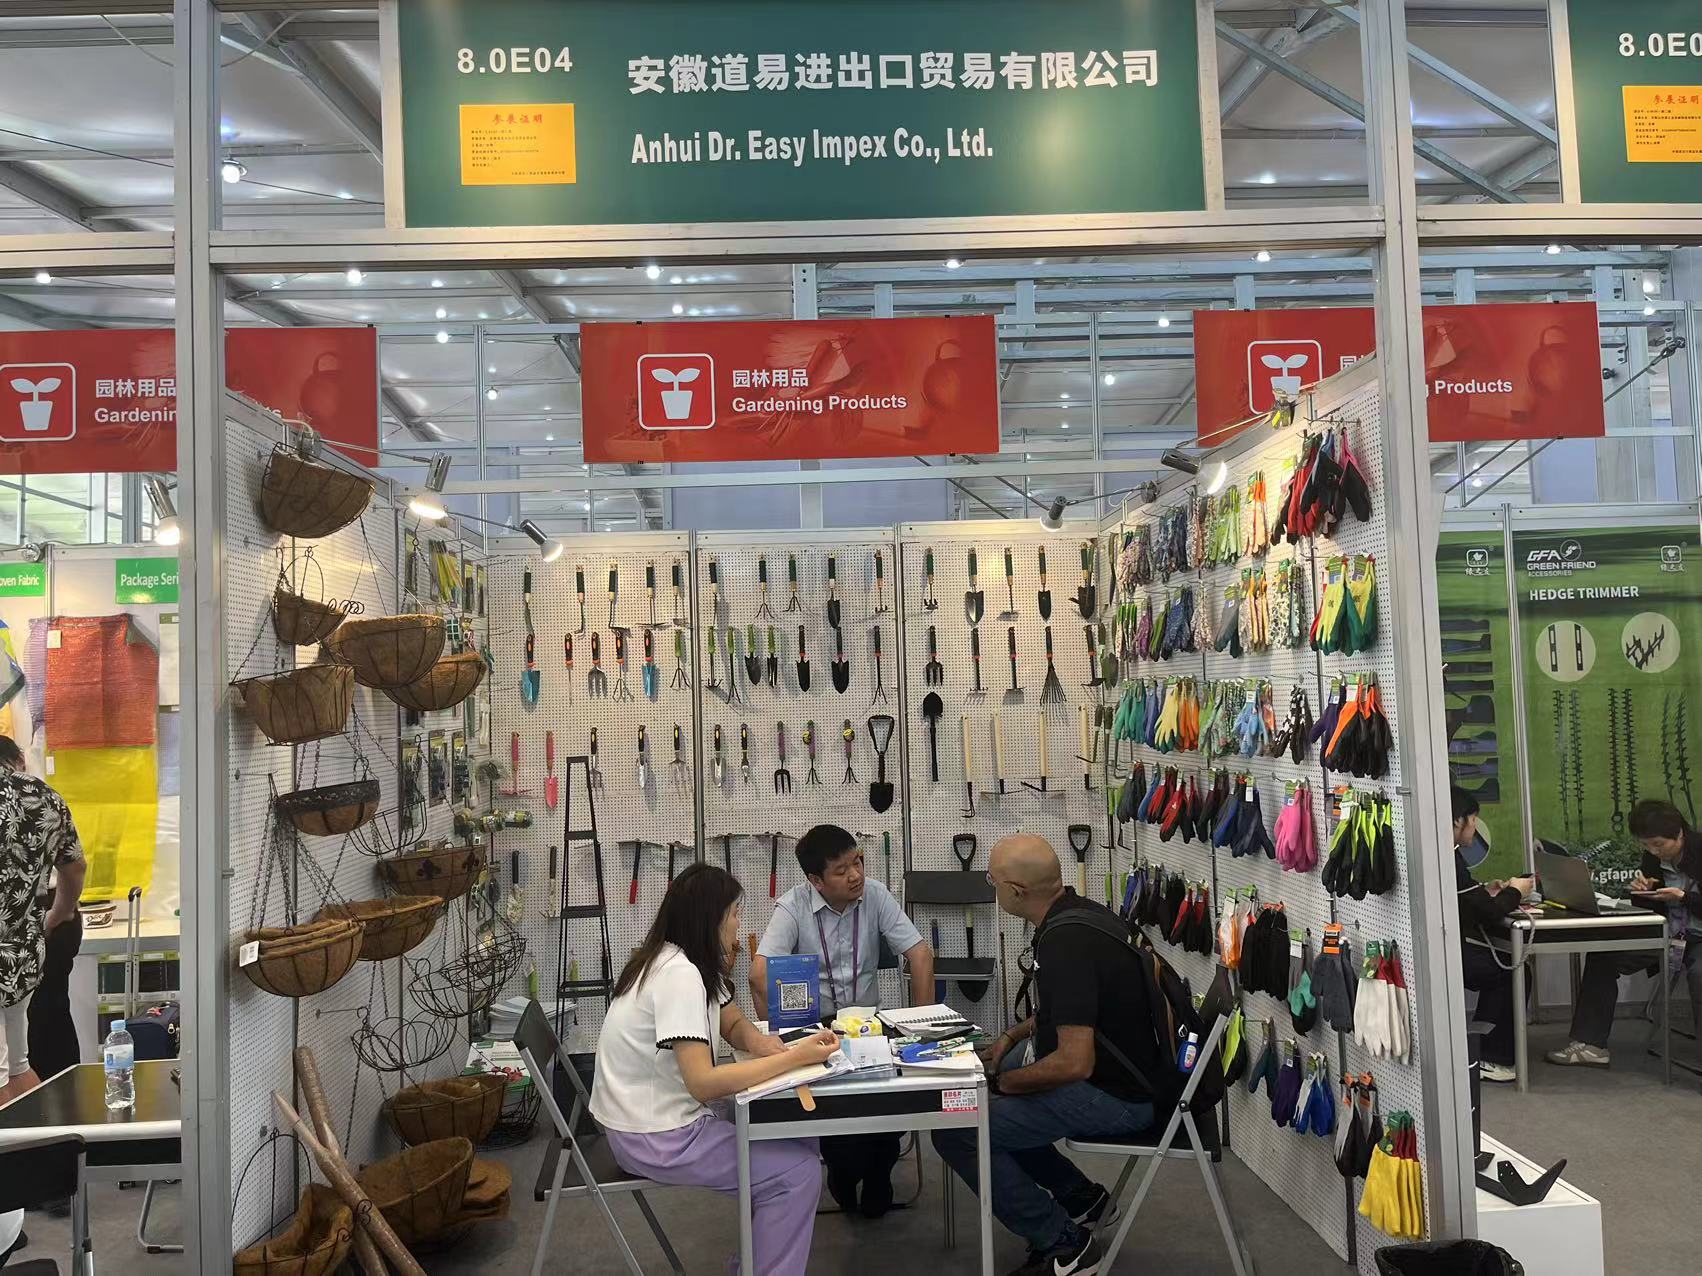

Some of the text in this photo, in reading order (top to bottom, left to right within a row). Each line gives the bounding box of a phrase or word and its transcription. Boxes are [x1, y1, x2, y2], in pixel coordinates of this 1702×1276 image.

[457, 46, 573, 74] 8.0E04
[628, 49, 1159, 95] 安徽道易进出口贸易有限公司
[632, 126, 993, 168] Anhui Dr. Easy Impex Co., Ltd.
[733, 369, 808, 388] 园林用品
[1435, 379, 1513, 395] Products
[96, 379, 176, 398] 园林用品
[733, 394, 907, 414] Gardening Products
[1527, 561, 1596, 571] GREEN FRIEND
[18, 574, 40, 586] Fabric
[121, 573, 158, 589] Package
[1530, 586, 1639, 601] HEDGE TRIMMER
[1590, 868, 1641, 884] .gfapro
